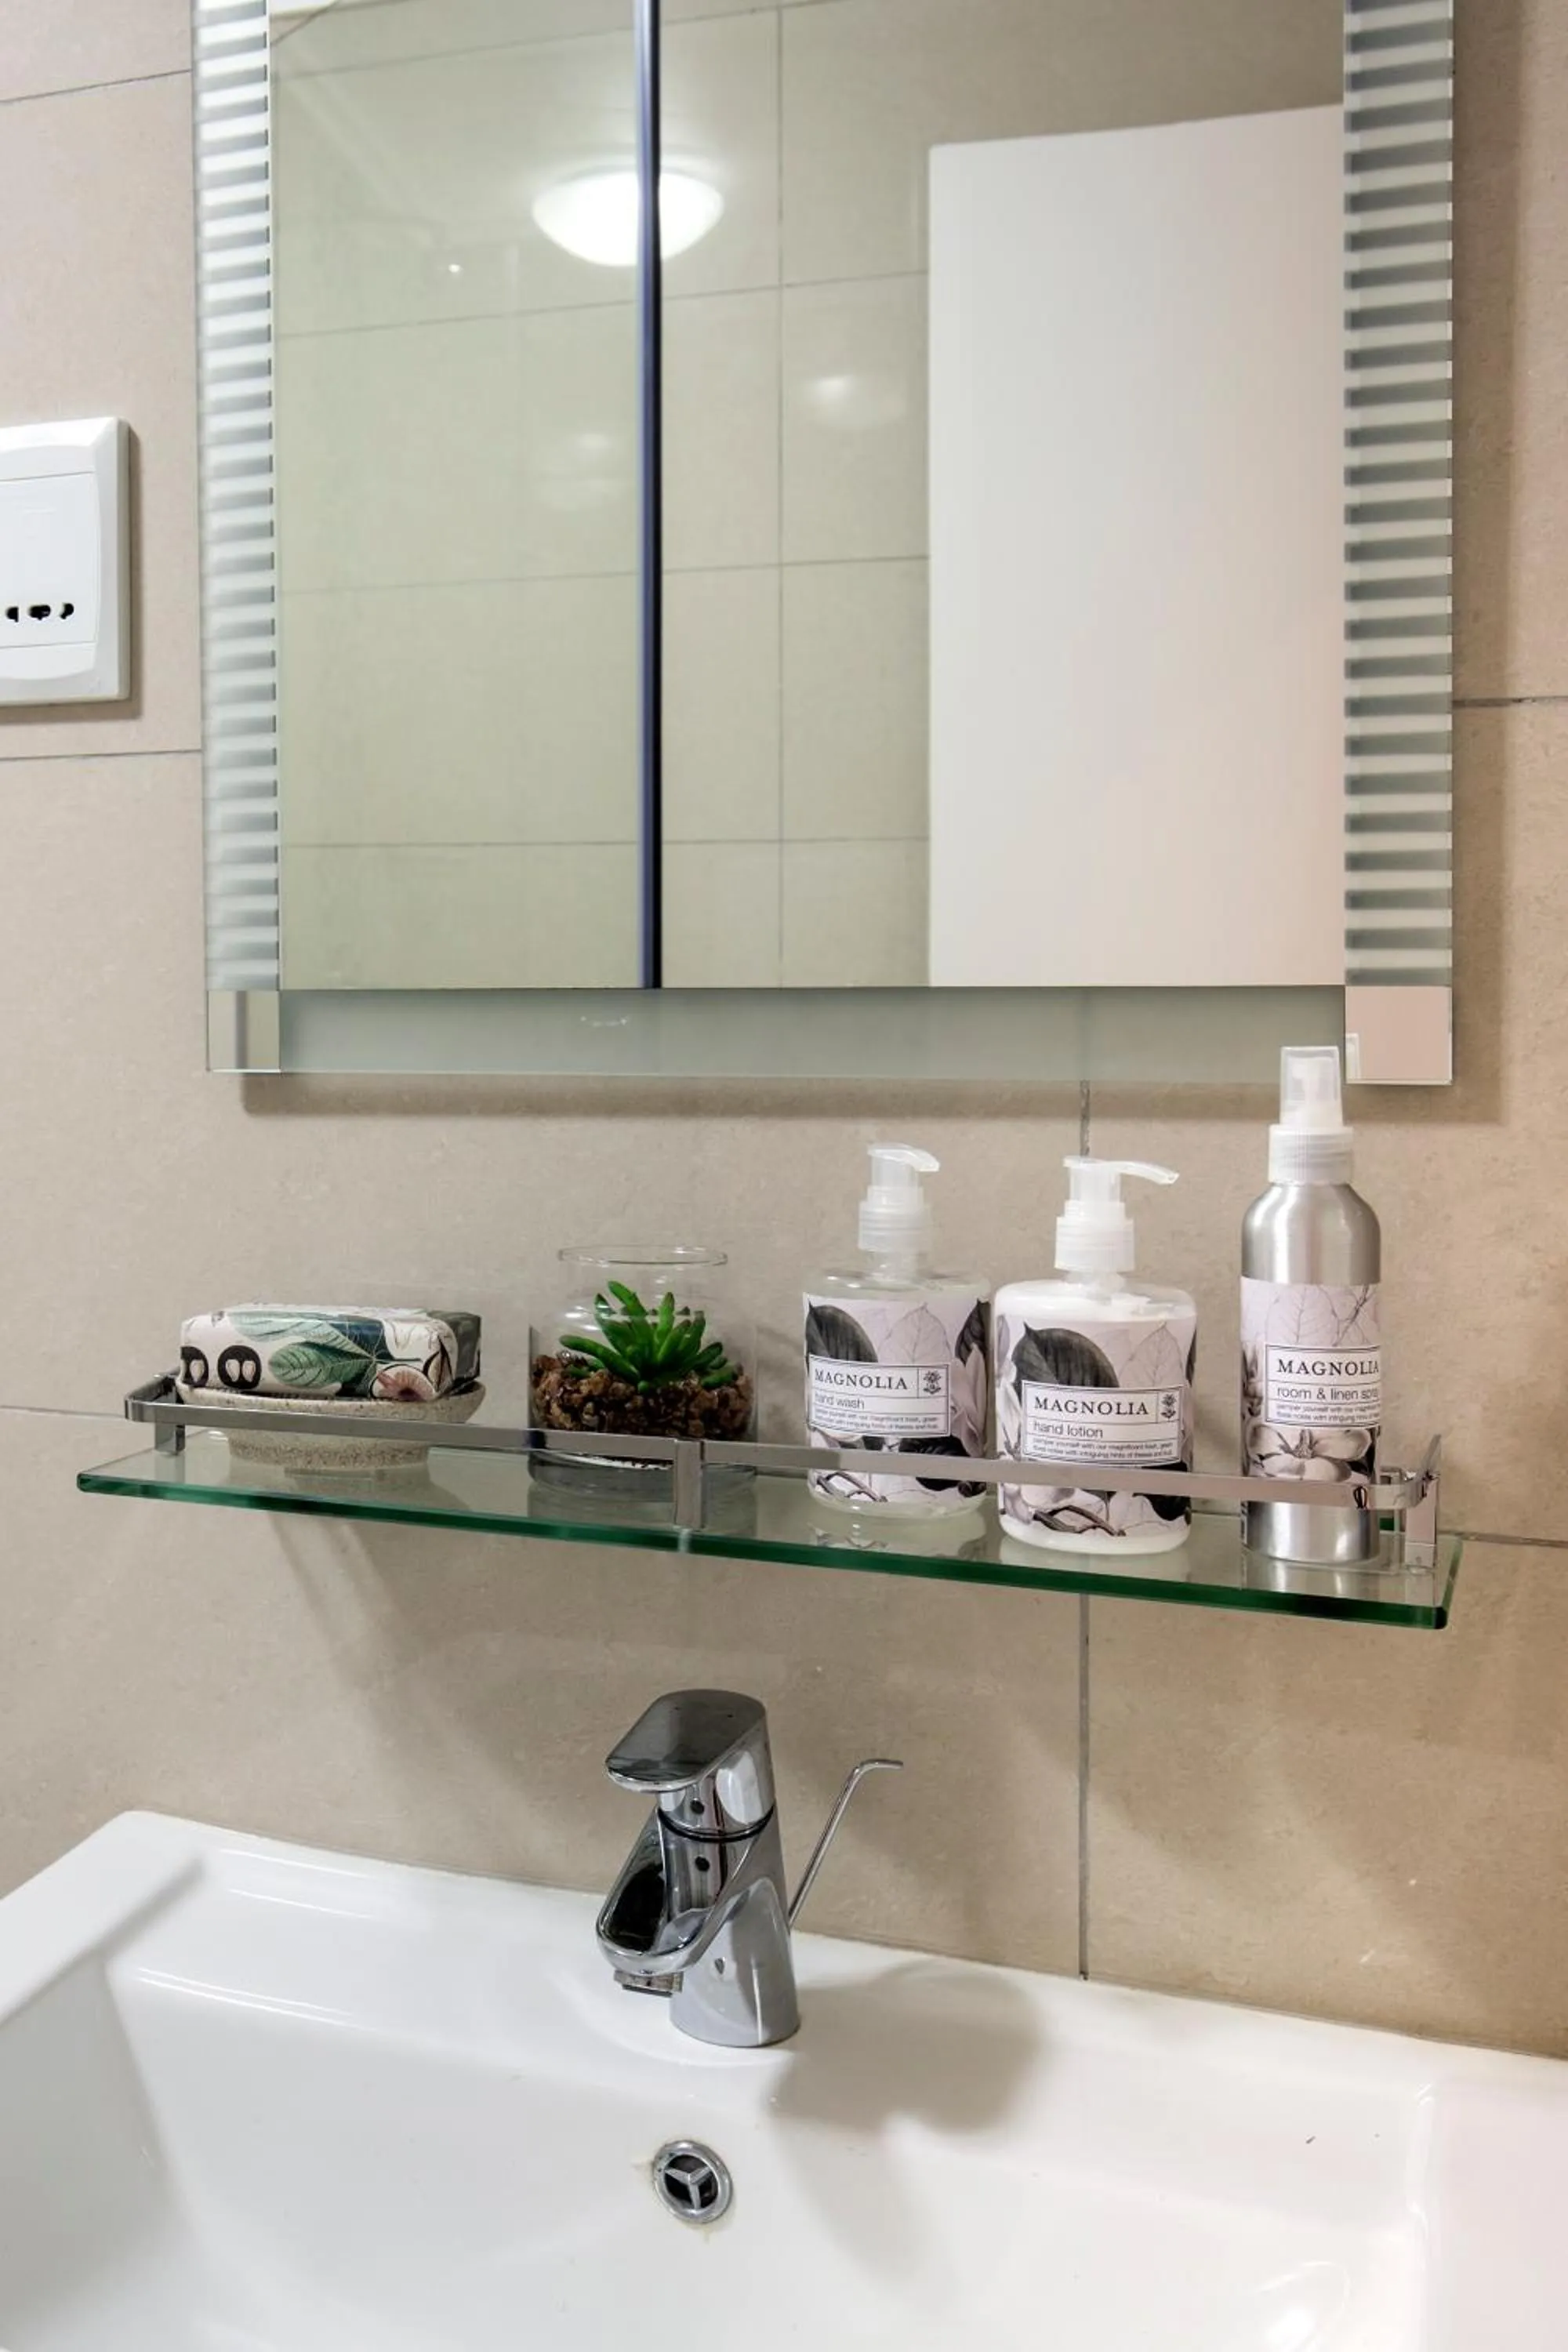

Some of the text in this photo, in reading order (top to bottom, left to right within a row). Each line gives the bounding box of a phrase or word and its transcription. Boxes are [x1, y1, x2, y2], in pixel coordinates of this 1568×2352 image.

[1278, 1359, 1380, 1376] MAGNOLIA
[815, 1368, 908, 1390] MAGNOLIA
[1277, 1387, 1312, 1399] room
[1316, 1387, 1327, 1399] &
[1330, 1388, 1359, 1401] linen
[837, 1398, 865, 1410] wash
[1033, 1396, 1149, 1416] MAGNOLIA
[1033, 1421, 1104, 1439] hand lotion
